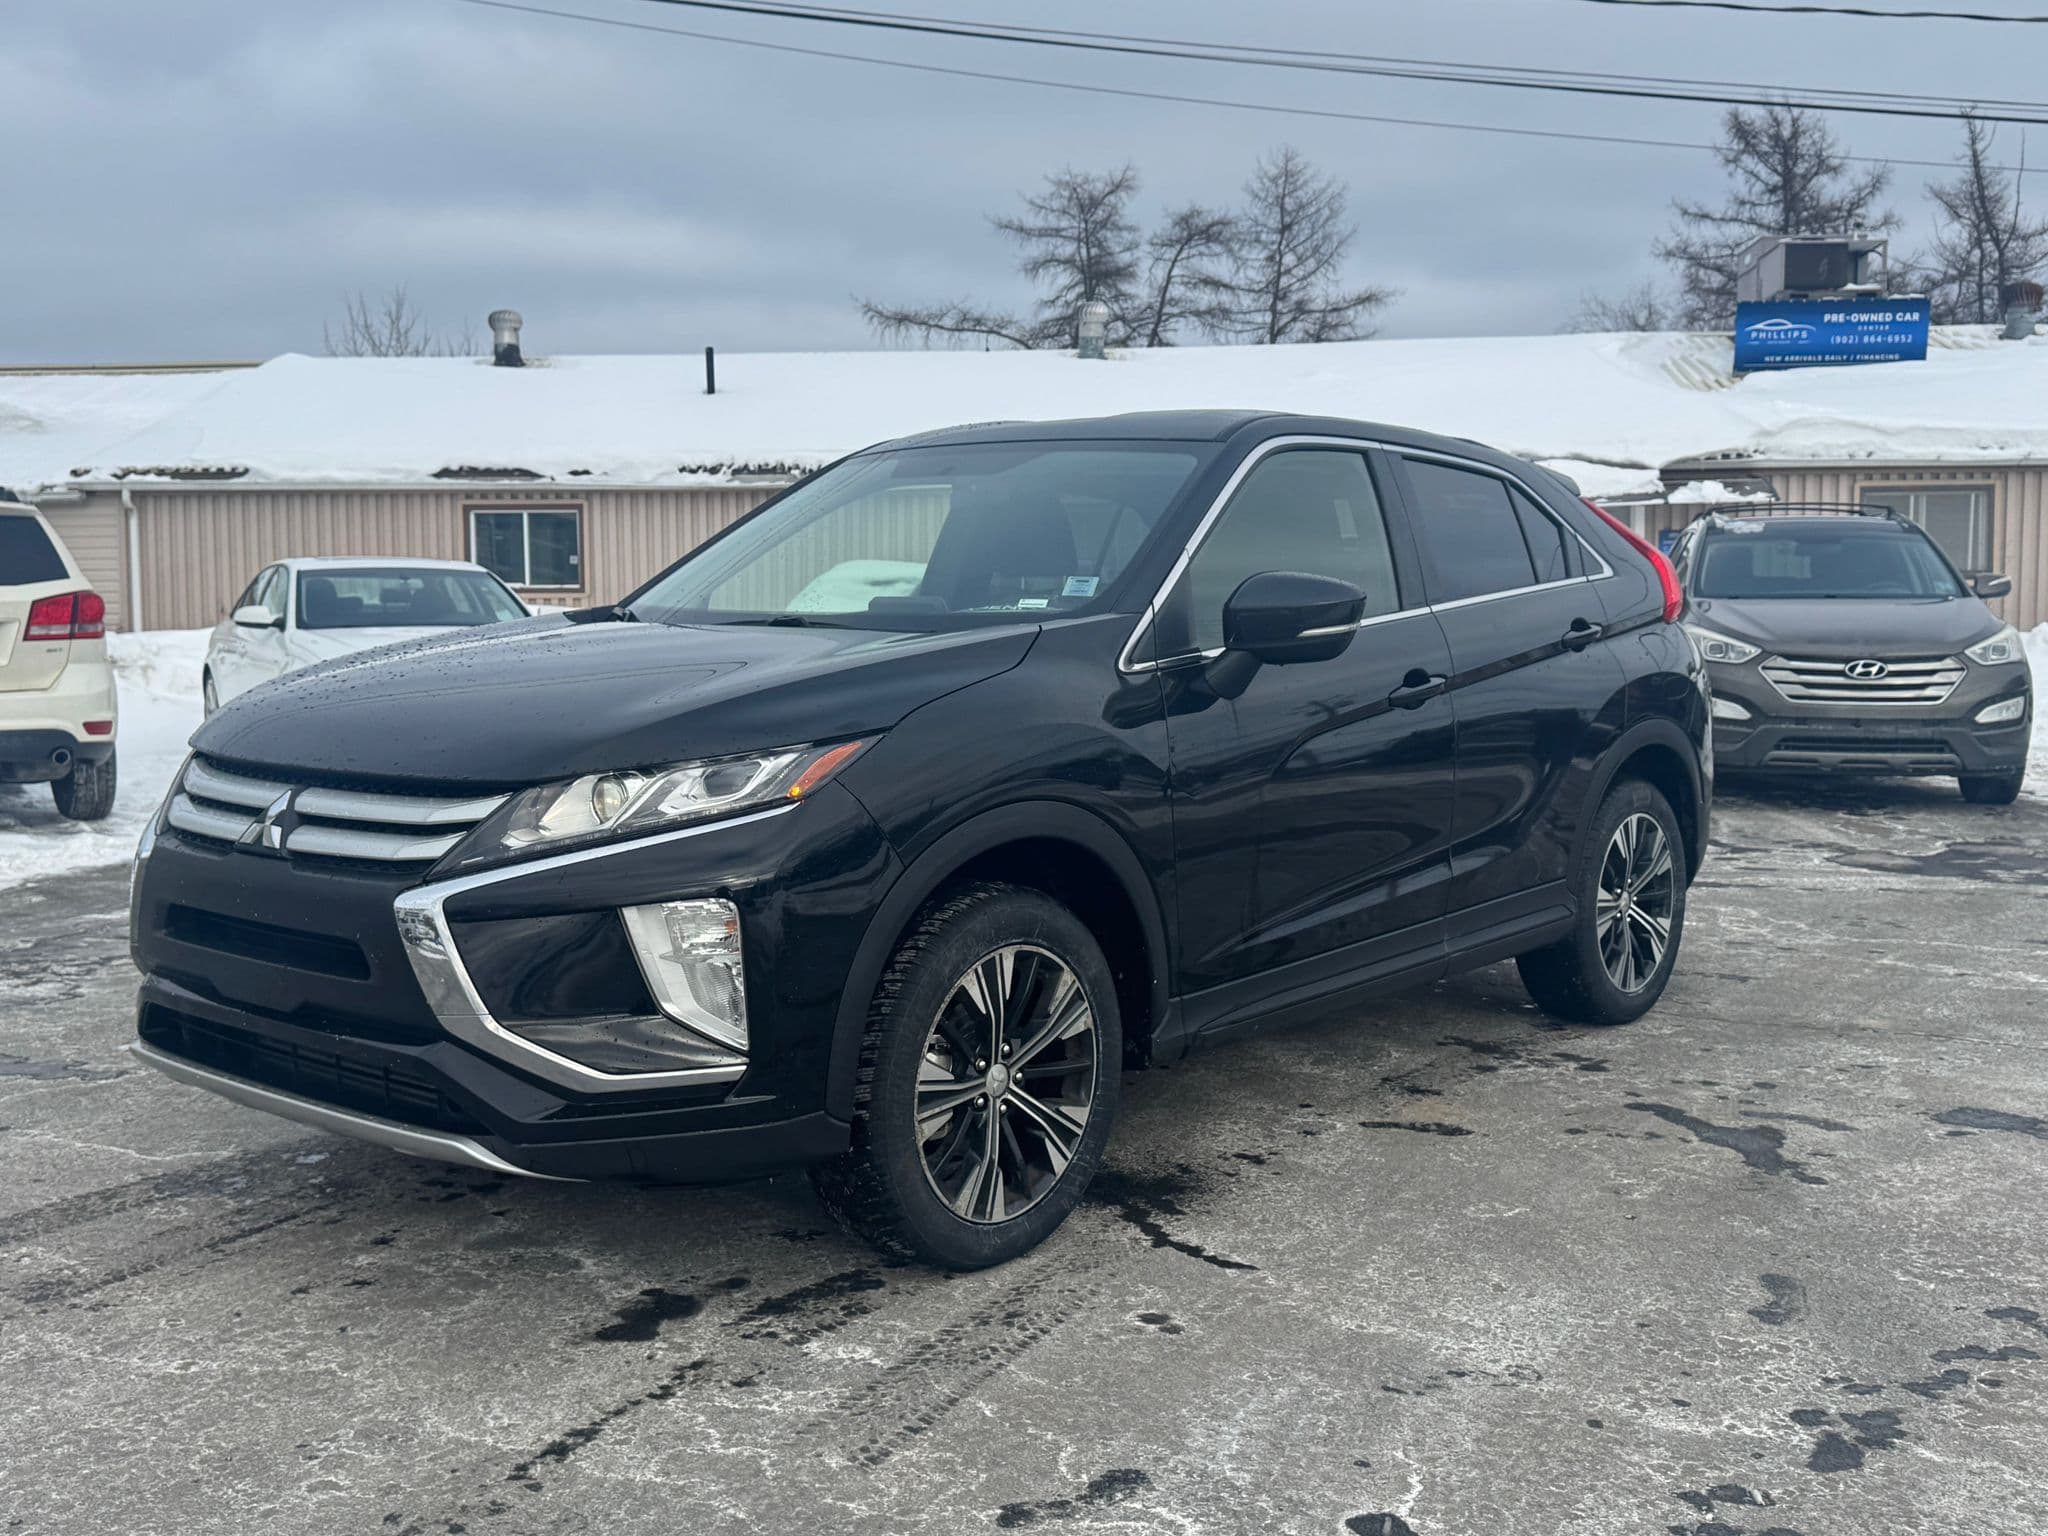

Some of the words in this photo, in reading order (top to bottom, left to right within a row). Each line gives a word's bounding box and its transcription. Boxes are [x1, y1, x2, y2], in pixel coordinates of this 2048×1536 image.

[1824, 313, 1893, 323] PRE-OWNED
[1896, 312, 1920, 322] CAR
[1751, 330, 1808, 339] PHILLIPS
[1830, 335, 1859, 344] (902)
